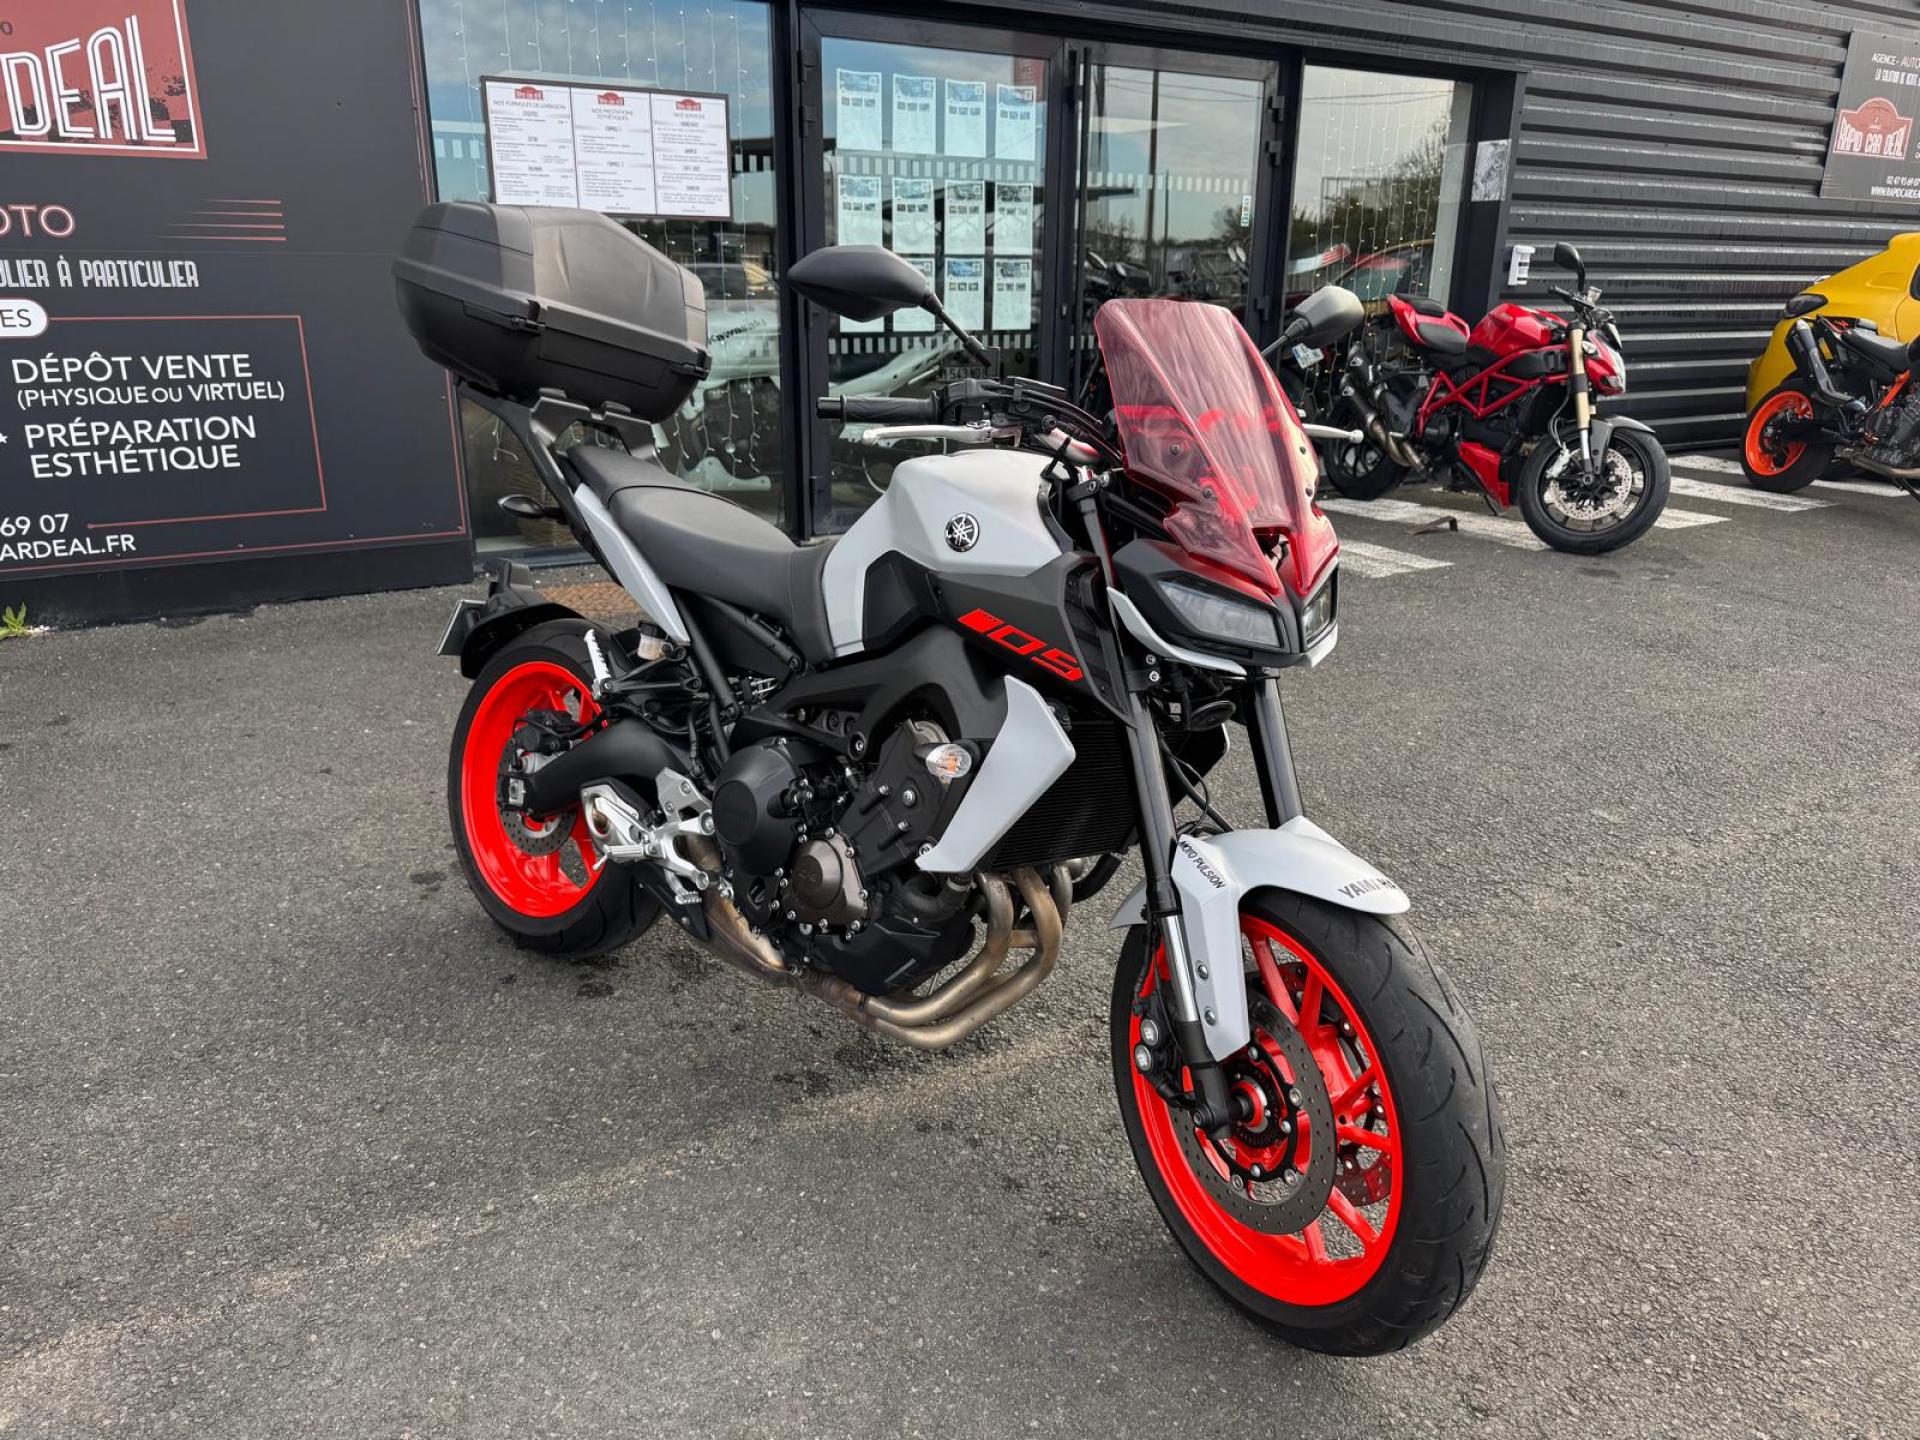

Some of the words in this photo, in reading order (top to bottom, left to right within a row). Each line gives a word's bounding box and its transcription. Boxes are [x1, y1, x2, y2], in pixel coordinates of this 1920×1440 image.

[0, 14, 176, 143] DEAL
[1837, 116, 1863, 152] RAPID
[1864, 132, 1883, 154] CAR
[1883, 124, 1907, 156] DEAL
[57, 254, 73, 288] À
[79, 260, 199, 288] PARTICULIER
[0, 308, 32, 328] ES
[12, 351, 133, 384] DÉPÔT
[142, 353, 253, 381] VENTE
[17, 386, 149, 411] (PHYSIQUE
[151, 386, 183, 403] OU
[188, 380, 286, 403] VIRTUEL)
[25, 414, 257, 449] PRÉPARATION
[30, 444, 241, 479] ESTHÉTIQUE
[0, 515, 31, 537] 69
[39, 513, 69, 534] 07
[0, 533, 137, 562] ARDEAL.FR
[1192, 857, 1226, 889] PULSION
